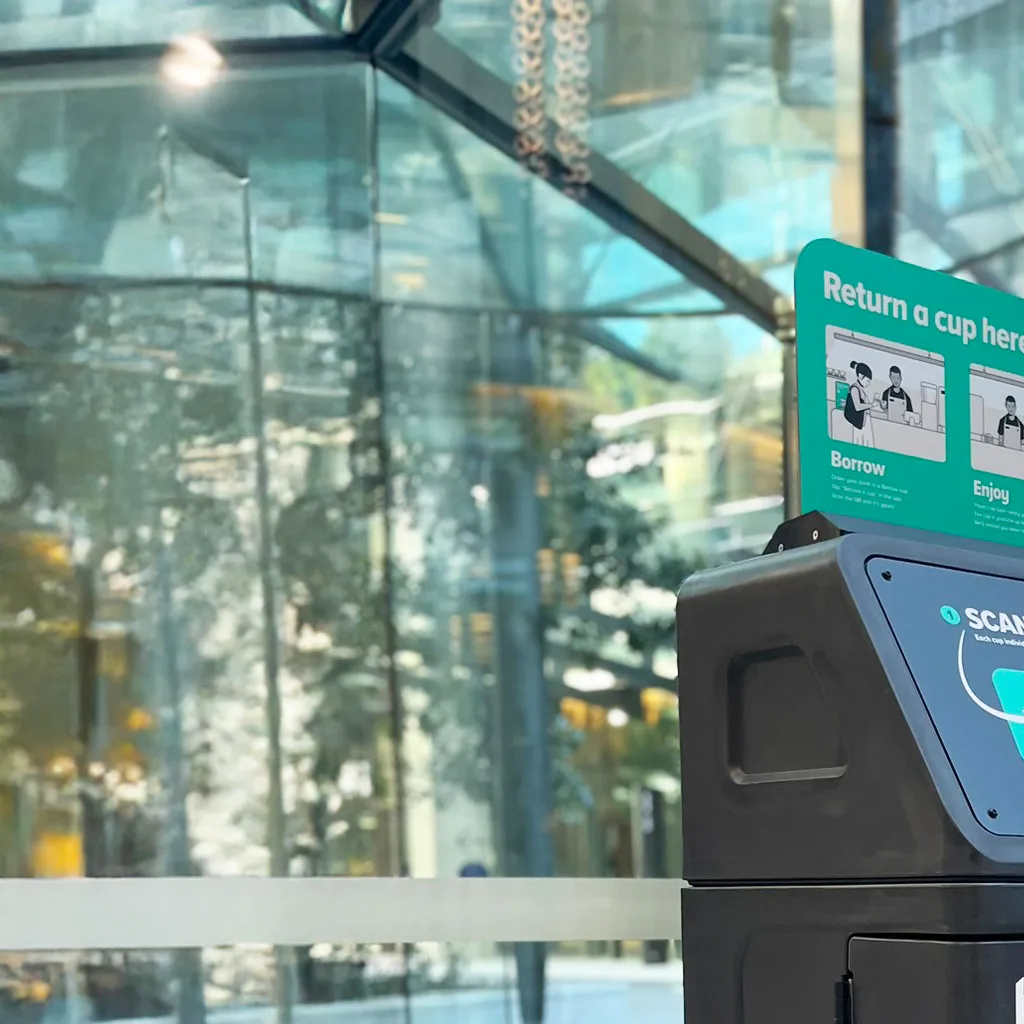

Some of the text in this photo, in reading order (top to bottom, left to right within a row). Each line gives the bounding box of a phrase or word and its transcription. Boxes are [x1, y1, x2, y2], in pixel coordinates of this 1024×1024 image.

[823, 270, 908, 321] Return
[913, 304, 929, 327] a
[935, 311, 977, 345] cup
[831, 449, 886, 477] Borrow
[973, 480, 1010, 505] Enjoy
[974, 633, 992, 642] Each
[991, 637, 1004, 645] cup
